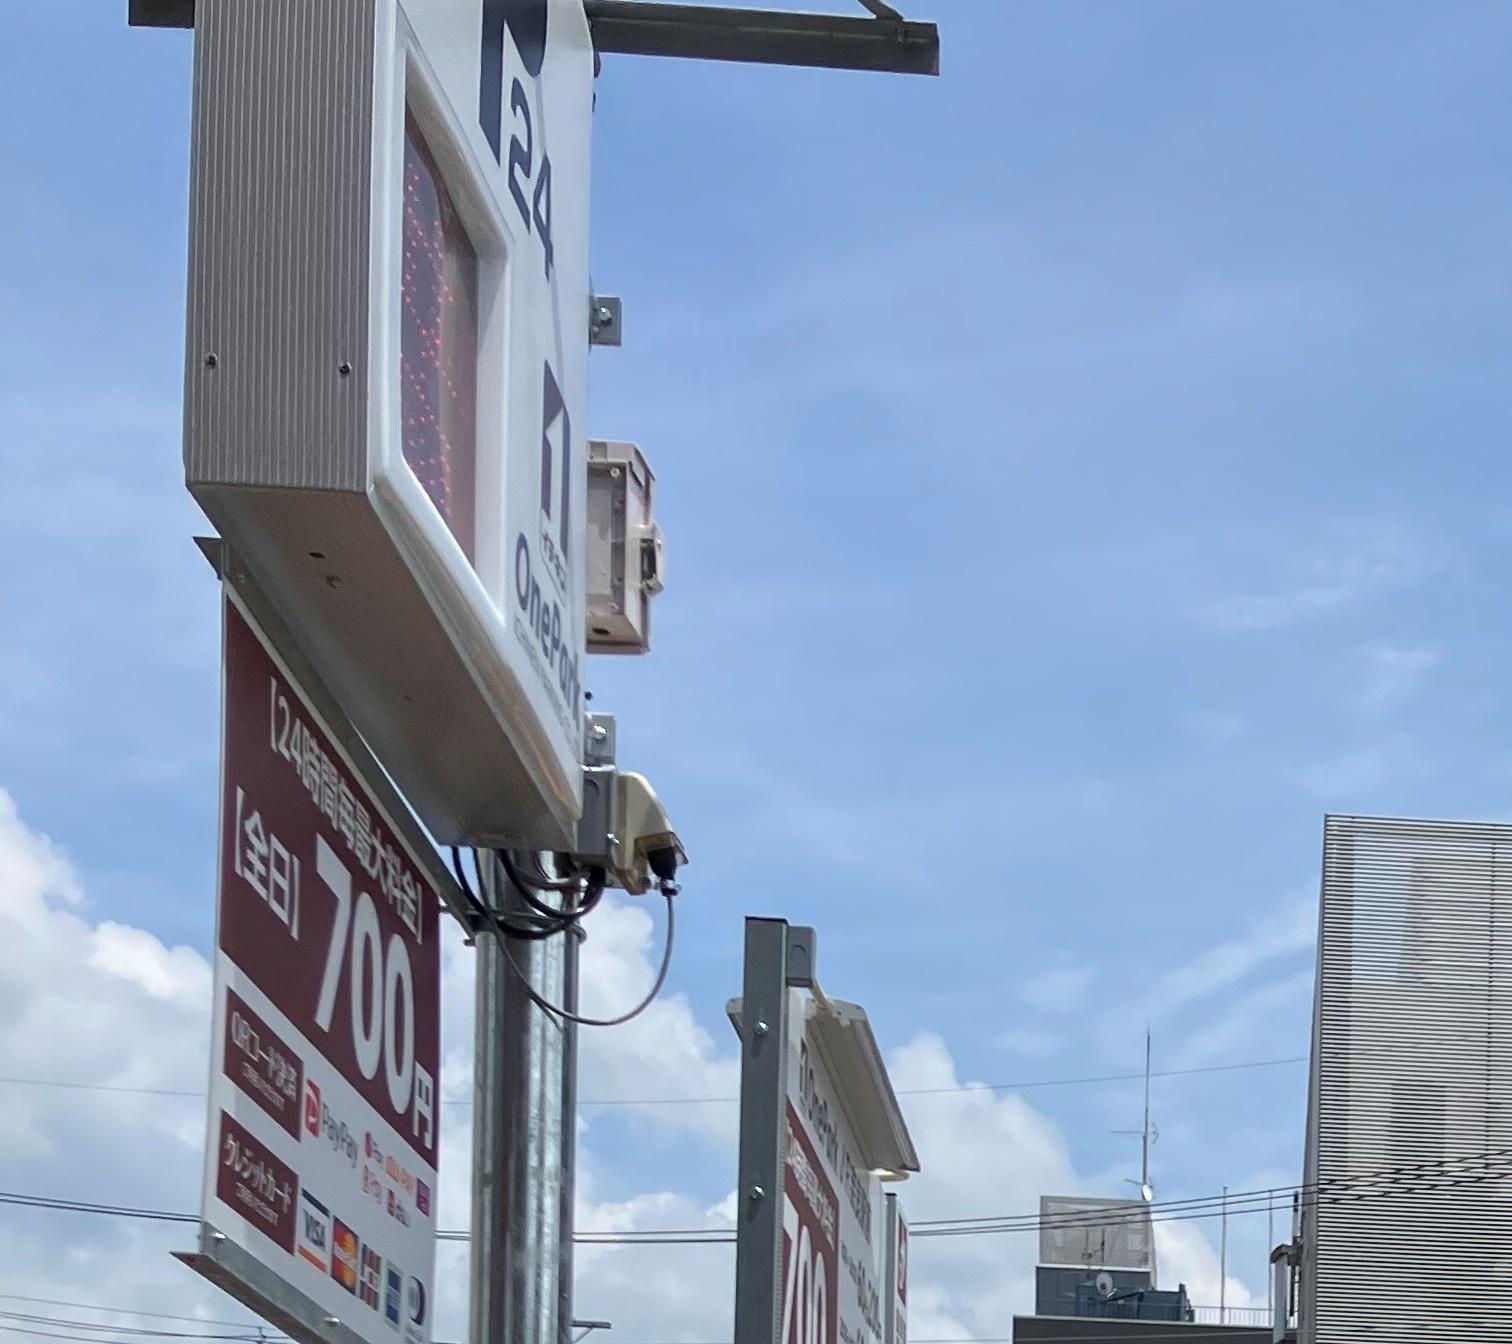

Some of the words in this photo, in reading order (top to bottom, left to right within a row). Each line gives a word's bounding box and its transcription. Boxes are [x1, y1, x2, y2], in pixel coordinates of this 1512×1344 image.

[508, 77, 555, 281] 24
[515, 532, 581, 732] OnePark
[321, 1102, 359, 1170] PayPay
